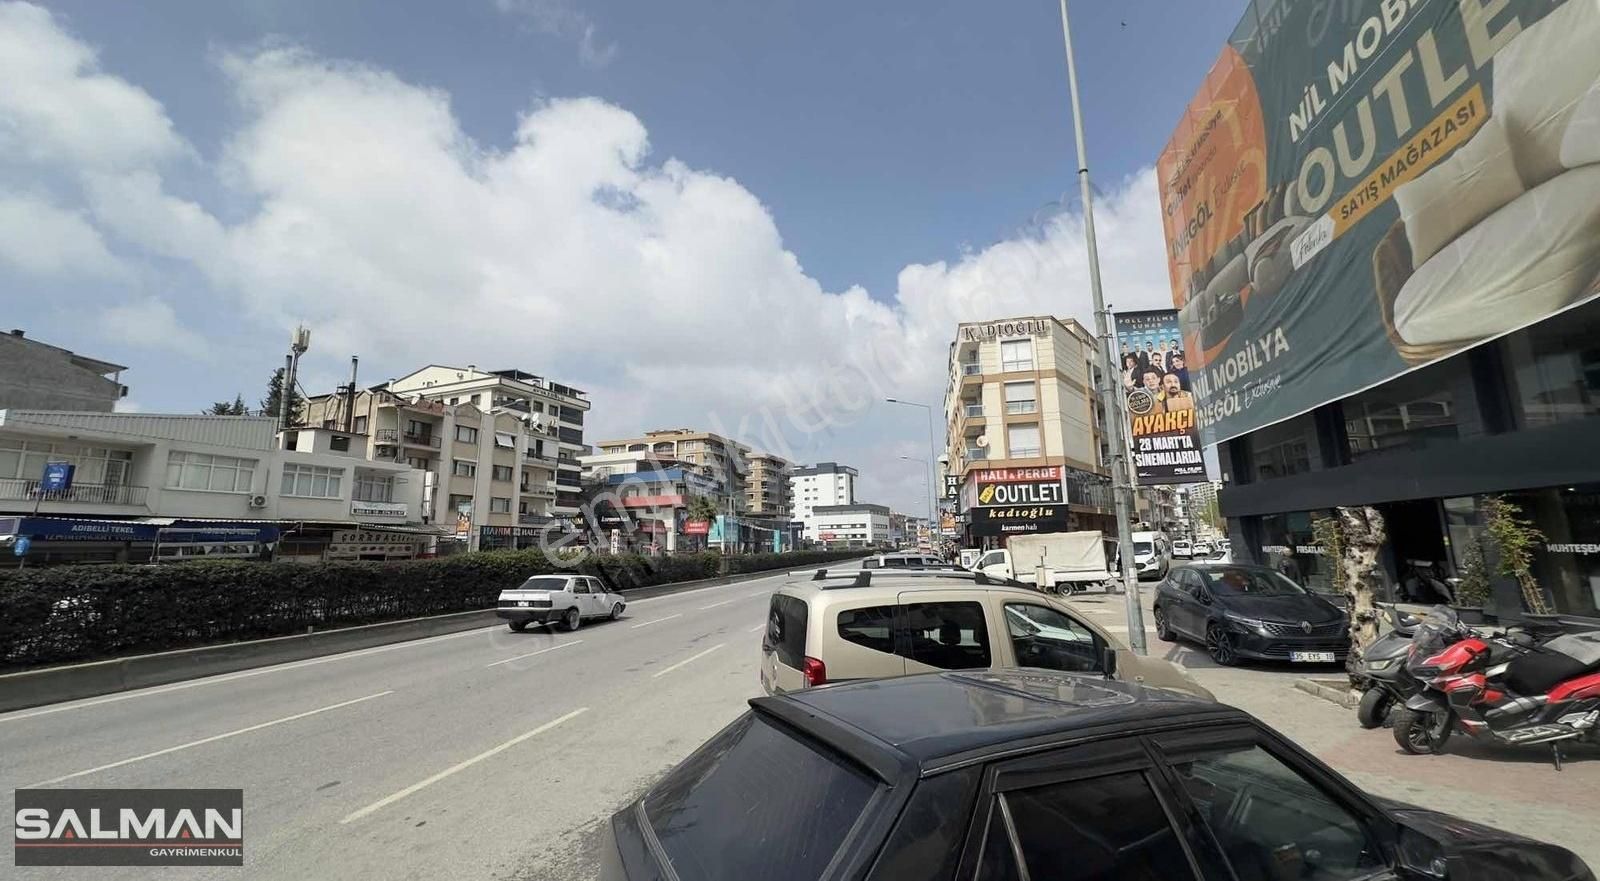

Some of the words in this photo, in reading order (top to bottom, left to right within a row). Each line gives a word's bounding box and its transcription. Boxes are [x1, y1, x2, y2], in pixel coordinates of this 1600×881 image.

[1288, 83, 1326, 142] NİL
[1327, 0, 1419, 95] MOB
[1297, 0, 1525, 212] OUTLE
[1340, 180, 1379, 220] SATIŞ
[1380, 101, 1477, 187] MAĞAZASI
[965, 320, 1046, 341] KADIOĞLU
[1192, 370, 1213, 401] NİL
[1213, 327, 1290, 392] MOBİLYA
[1243, 374, 1281, 409] Exclusive
[1133, 408, 1194, 436] AYAKÇI
[1139, 438, 1151, 451] 28
[1152, 435, 1193, 450] MART'TA
[1136, 450, 1202, 467] SİNEMALARDA
[981, 470, 1007, 480] HALI
[1018, 468, 1057, 479] PERDE
[994, 483, 1060, 503] OUTLET
[111, 526, 135, 534] TEKEL
[1001, 523, 1025, 531] karmen
